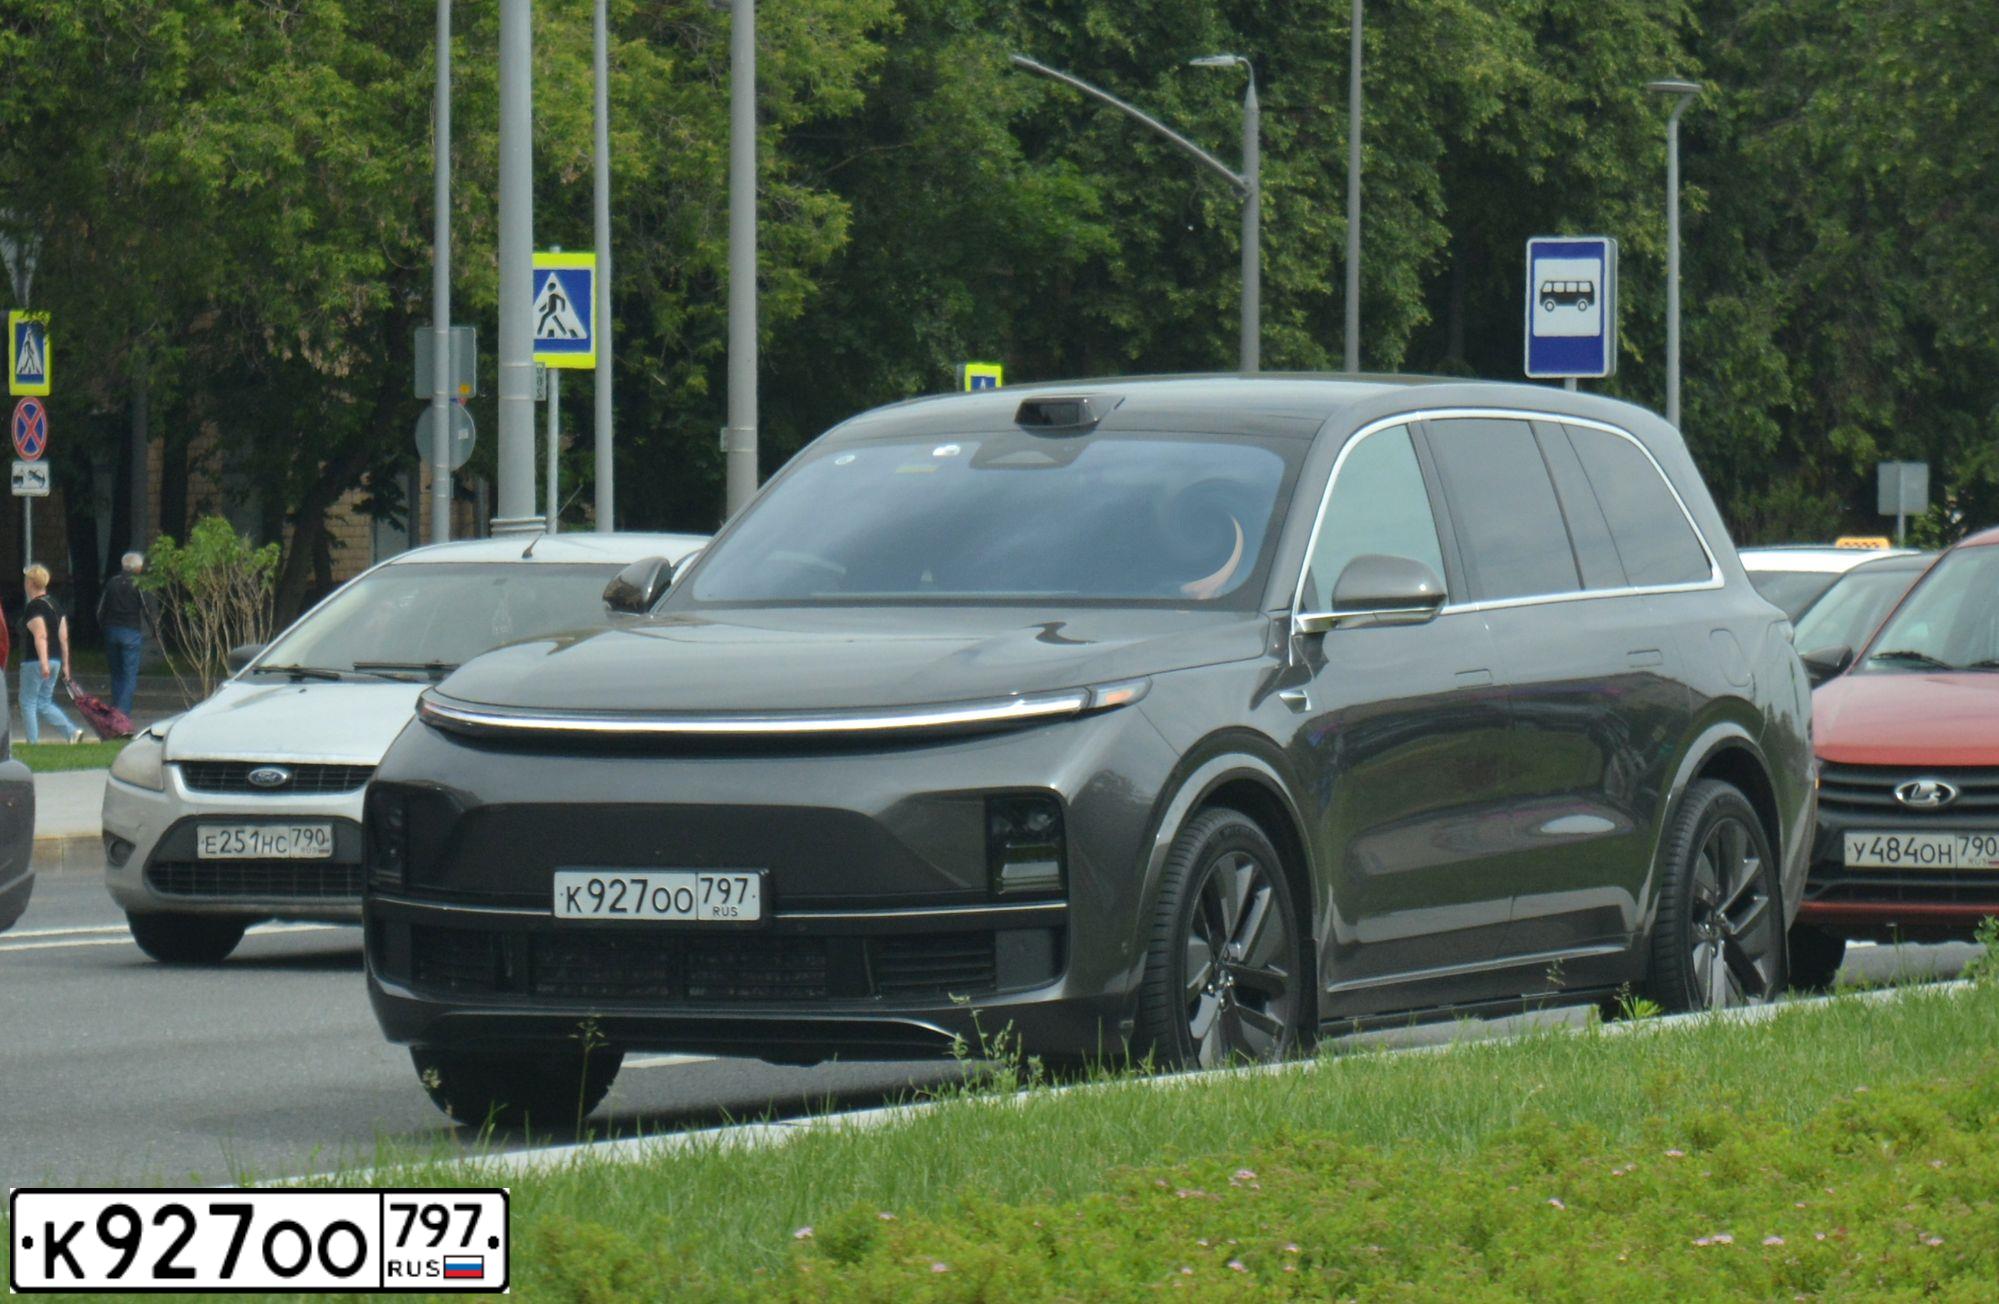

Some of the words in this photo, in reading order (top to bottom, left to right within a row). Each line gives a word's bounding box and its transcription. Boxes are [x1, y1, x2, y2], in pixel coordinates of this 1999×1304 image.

[292, 828, 326, 847] 790
[1853, 837, 1952, 864] У484ОН
[1958, 837, 1998, 857] 790
[566, 878, 694, 914] К927ОО
[700, 877, 749, 905] 797
[712, 906, 739, 917] RUS
